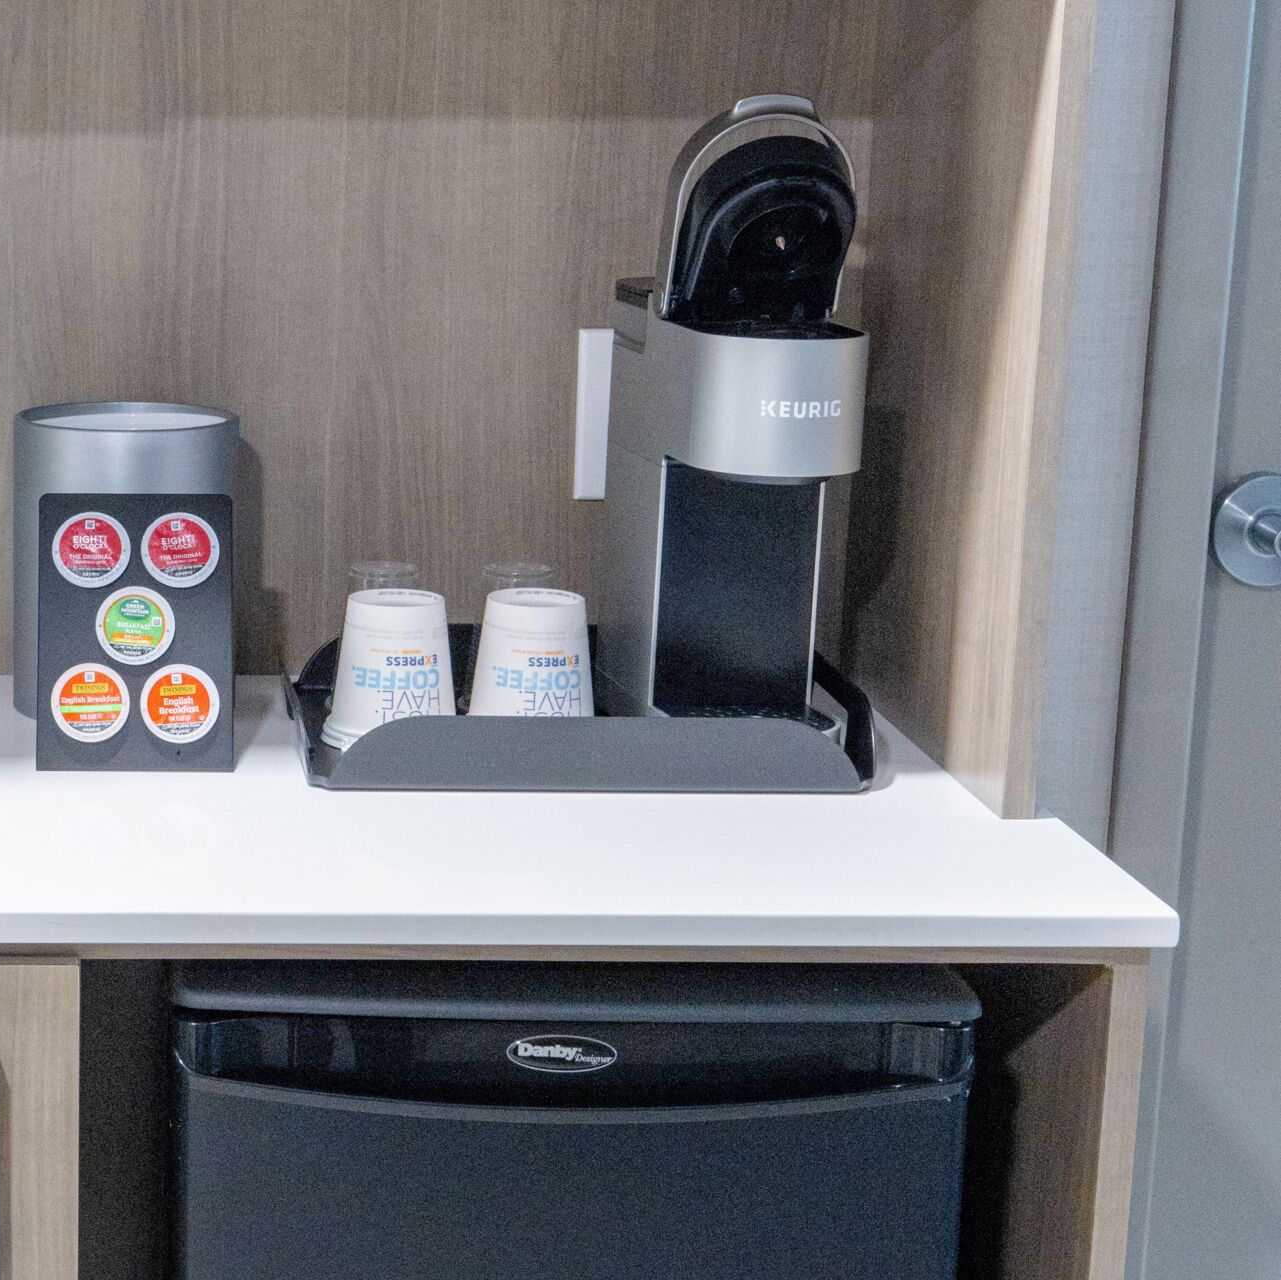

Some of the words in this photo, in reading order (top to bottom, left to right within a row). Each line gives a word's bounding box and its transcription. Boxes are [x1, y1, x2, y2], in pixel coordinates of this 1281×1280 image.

[760, 400, 841, 418] KEURIG
[73, 535, 103, 544] EIGHT
[161, 535, 192, 545] EIGHT
[173, 551, 202, 560] ORIGINAL
[116, 621, 151, 629] BREAKFAST
[386, 654, 438, 667] EXPRESS
[528, 655, 580, 668] EXPRESS
[352, 666, 440, 690] COFFEE.
[493, 666, 581, 691] COFFEE.
[61, 696, 86, 704] English
[163, 696, 194, 706] English
[377, 688, 440, 710] HAVE.
[519, 688, 582, 711] HAVE.
[159, 705, 199, 714] Breakfast
[517, 1042, 577, 1060] Danby
[575, 1053, 613, 1065] Designer
